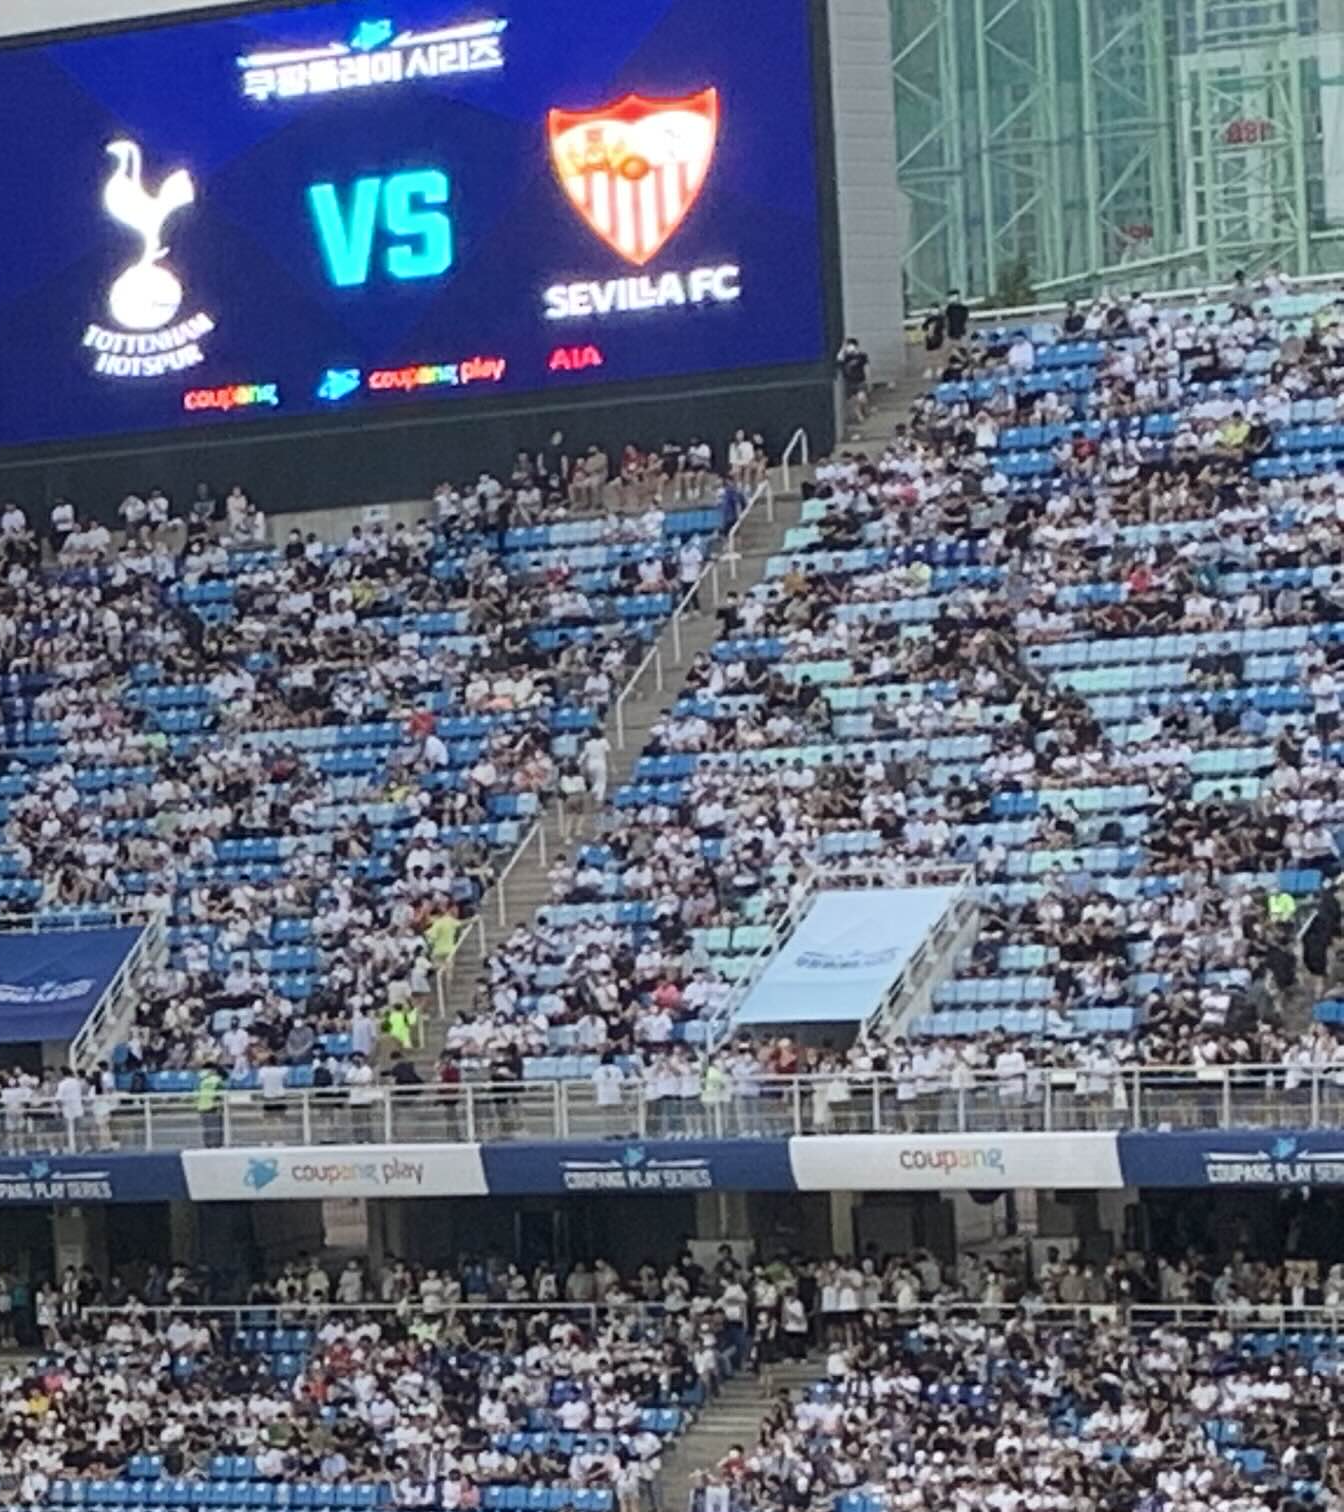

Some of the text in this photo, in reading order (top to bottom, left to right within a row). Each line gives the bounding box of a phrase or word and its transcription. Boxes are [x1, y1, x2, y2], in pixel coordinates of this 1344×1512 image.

[406, 36, 504, 77] 시리즈
[310, 169, 452, 288] VS
[544, 264, 741, 320] SEVILLA FC
[83, 312, 214, 354] TOTTENHAM
[94, 344, 205, 377] HOTSPUR
[548, 345, 603, 371] AIA
[368, 356, 506, 391] coupang play
[183, 382, 279, 411] coupang
[291, 1157, 424, 1186] coupang play
[900, 1147, 1006, 1176] coupang
[1275, 1162, 1311, 1182] PLAY
[33, 1182, 64, 1199] PLAY
[628, 1170, 662, 1188] PLAY
